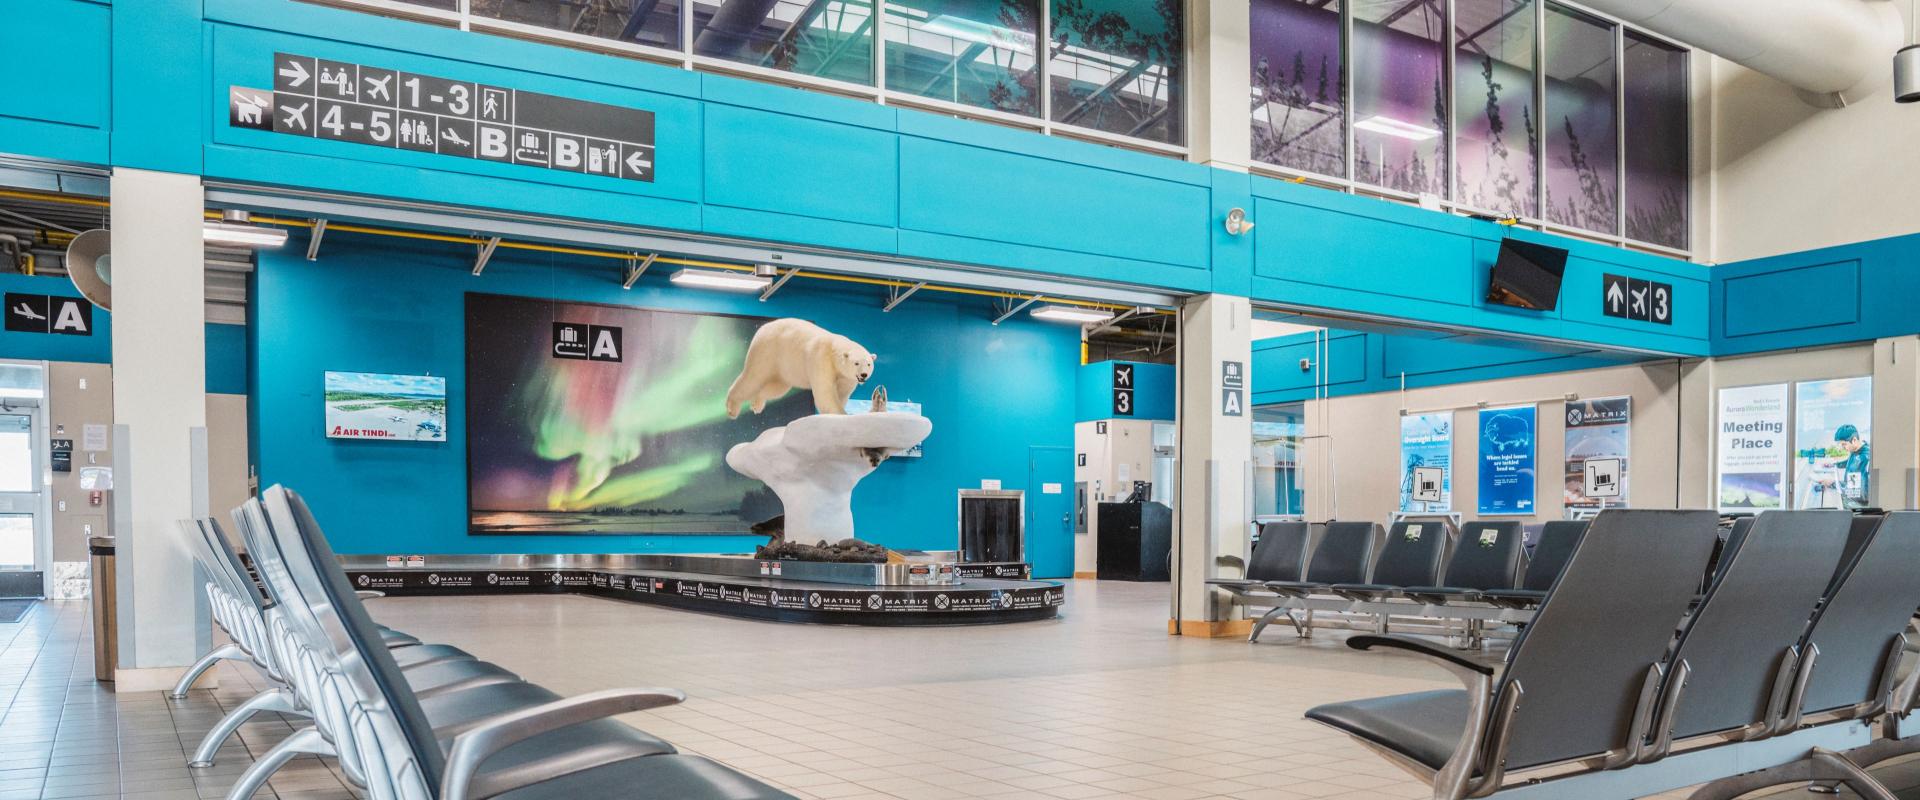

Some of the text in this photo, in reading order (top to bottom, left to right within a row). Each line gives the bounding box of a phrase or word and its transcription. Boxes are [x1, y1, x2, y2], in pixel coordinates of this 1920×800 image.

[480, 126, 508, 158] B
[555, 137, 581, 167] B
[1655, 287, 1668, 321] 3
[53, 301, 88, 332] A
[591, 329, 619, 359] A
[1117, 391, 1130, 413] 3
[1224, 391, 1241, 414] A
[1584, 410, 1626, 419] MATRIX
[361, 429, 388, 437] TINDI
[1723, 420, 1783, 434] Meeting
[63, 440, 70, 448] A
[1731, 438, 1773, 449] Place
[1013, 595, 1042, 603] MATRIX
